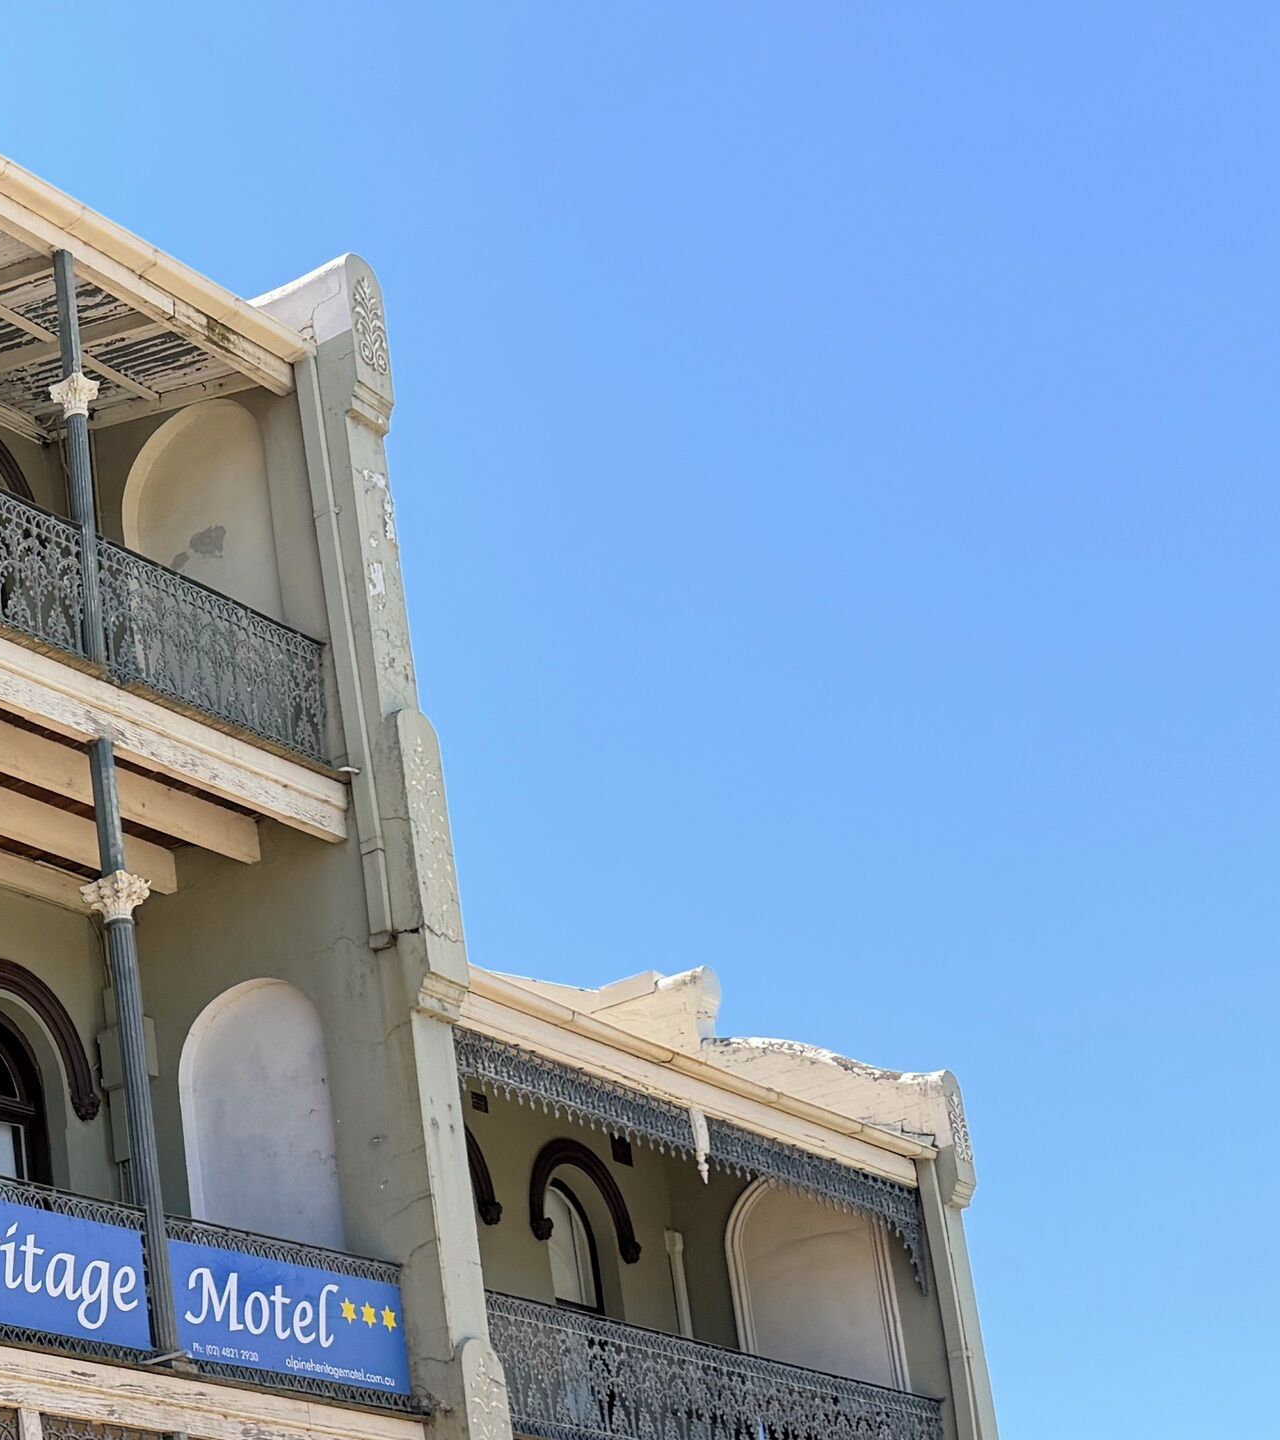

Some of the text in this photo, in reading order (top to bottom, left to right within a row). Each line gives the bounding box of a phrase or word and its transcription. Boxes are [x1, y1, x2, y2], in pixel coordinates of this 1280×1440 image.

[183, 1267, 340, 1349] Motel
[205, 1344, 220, 1358] (02)
[221, 1347, 239, 1359] 4821
[240, 1349, 259, 1362] 2930
[285, 1355, 396, 1387] alpineheritagemotel.com.au
